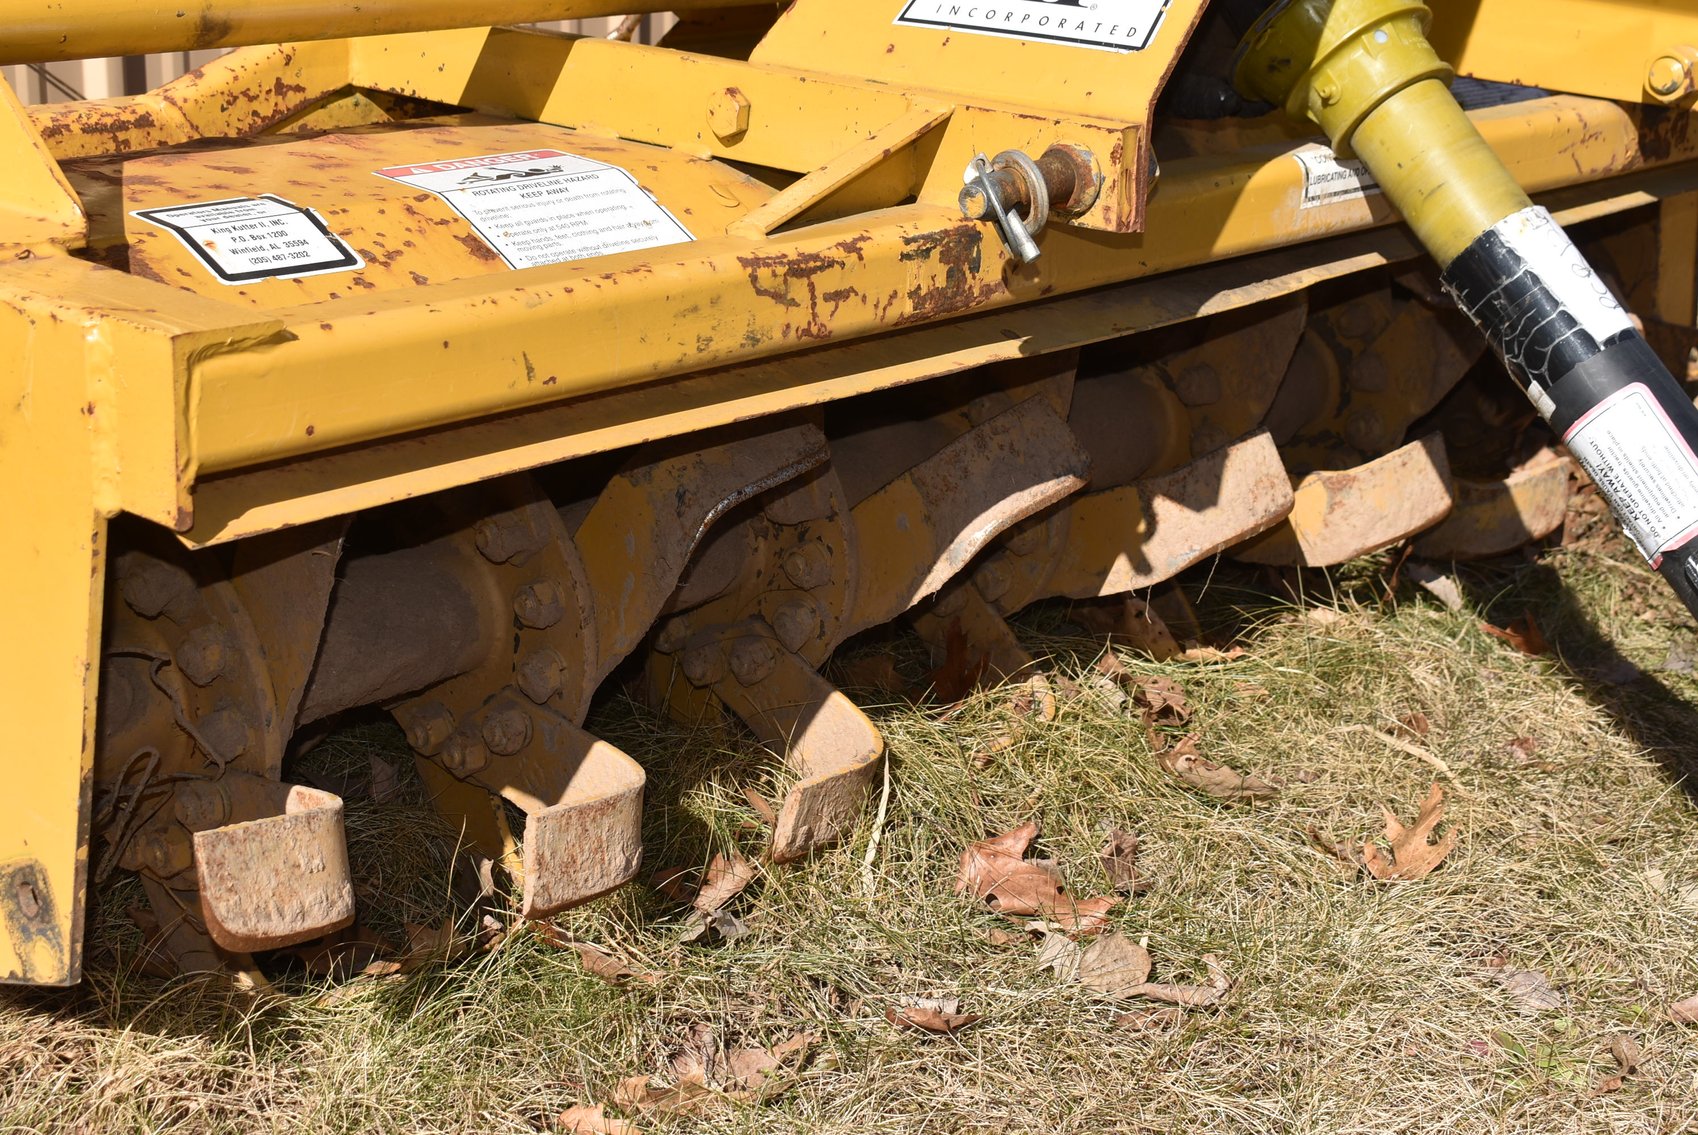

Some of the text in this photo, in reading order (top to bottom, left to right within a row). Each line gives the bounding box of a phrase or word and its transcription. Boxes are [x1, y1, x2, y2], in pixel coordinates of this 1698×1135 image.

[936, 4, 1138, 38] INCORPORATED
[432, 153, 533, 170] DANGER
[472, 174, 599, 196] ROTATING DRIVELINE HAZARD
[1310, 170, 1346, 186] LUBRICATING
[1348, 167, 1359, 178] AND
[510, 202, 535, 210] serious
[600, 188, 626, 196] rotating
[519, 187, 569, 199] KEEP AWAY
[210, 226, 233, 234] King
[231, 223, 258, 232] Kutter
[270, 218, 289, 227] INC.
[523, 217, 549, 226] guards
[231, 230, 289, 244] P.O. Box 1200
[571, 229, 599, 237] clothing
[228, 244, 270, 256] Winfield,
[282, 239, 310, 249] 35594
[516, 244, 544, 252] moving
[550, 249, 577, 257] operate
[577, 244, 602, 252] without
[602, 240, 630, 248] driveline
[630, 235, 659, 243] securely
[248, 250, 312, 266] (205) 487-3202
[1605, 428, 1620, 446] place
[1606, 445, 1622, 466] tractor
[1621, 452, 1639, 475] shields
[1636, 456, 1656, 483] securely
[1589, 439, 1660, 538] DO NOT OPERATE WITHOUT
[1594, 462, 1640, 522] KEEP AWAY!
[1597, 476, 1614, 498] CAUSE
[1635, 473, 1661, 506] equipment
[1612, 498, 1624, 512] CAN
[1636, 487, 1657, 515] driveline
[1654, 513, 1663, 523] All
[1658, 505, 1670, 518] and
